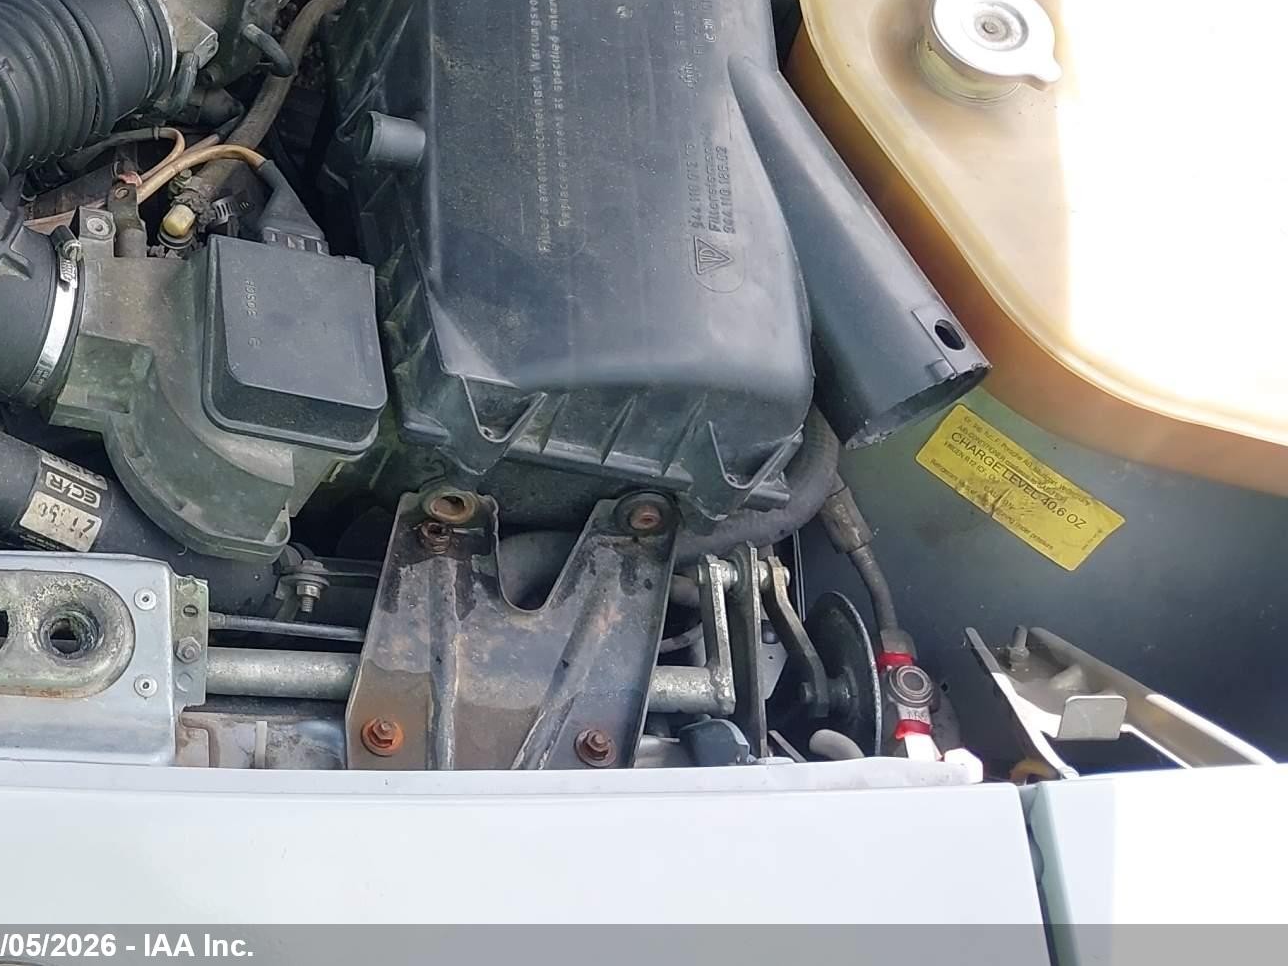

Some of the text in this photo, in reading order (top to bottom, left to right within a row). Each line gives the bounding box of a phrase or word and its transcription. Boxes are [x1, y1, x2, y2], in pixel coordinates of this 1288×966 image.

[951, 432, 1002, 473] CHARGE
[1002, 465, 1043, 501] LEVEL
[1067, 512, 1088, 530] OZ
